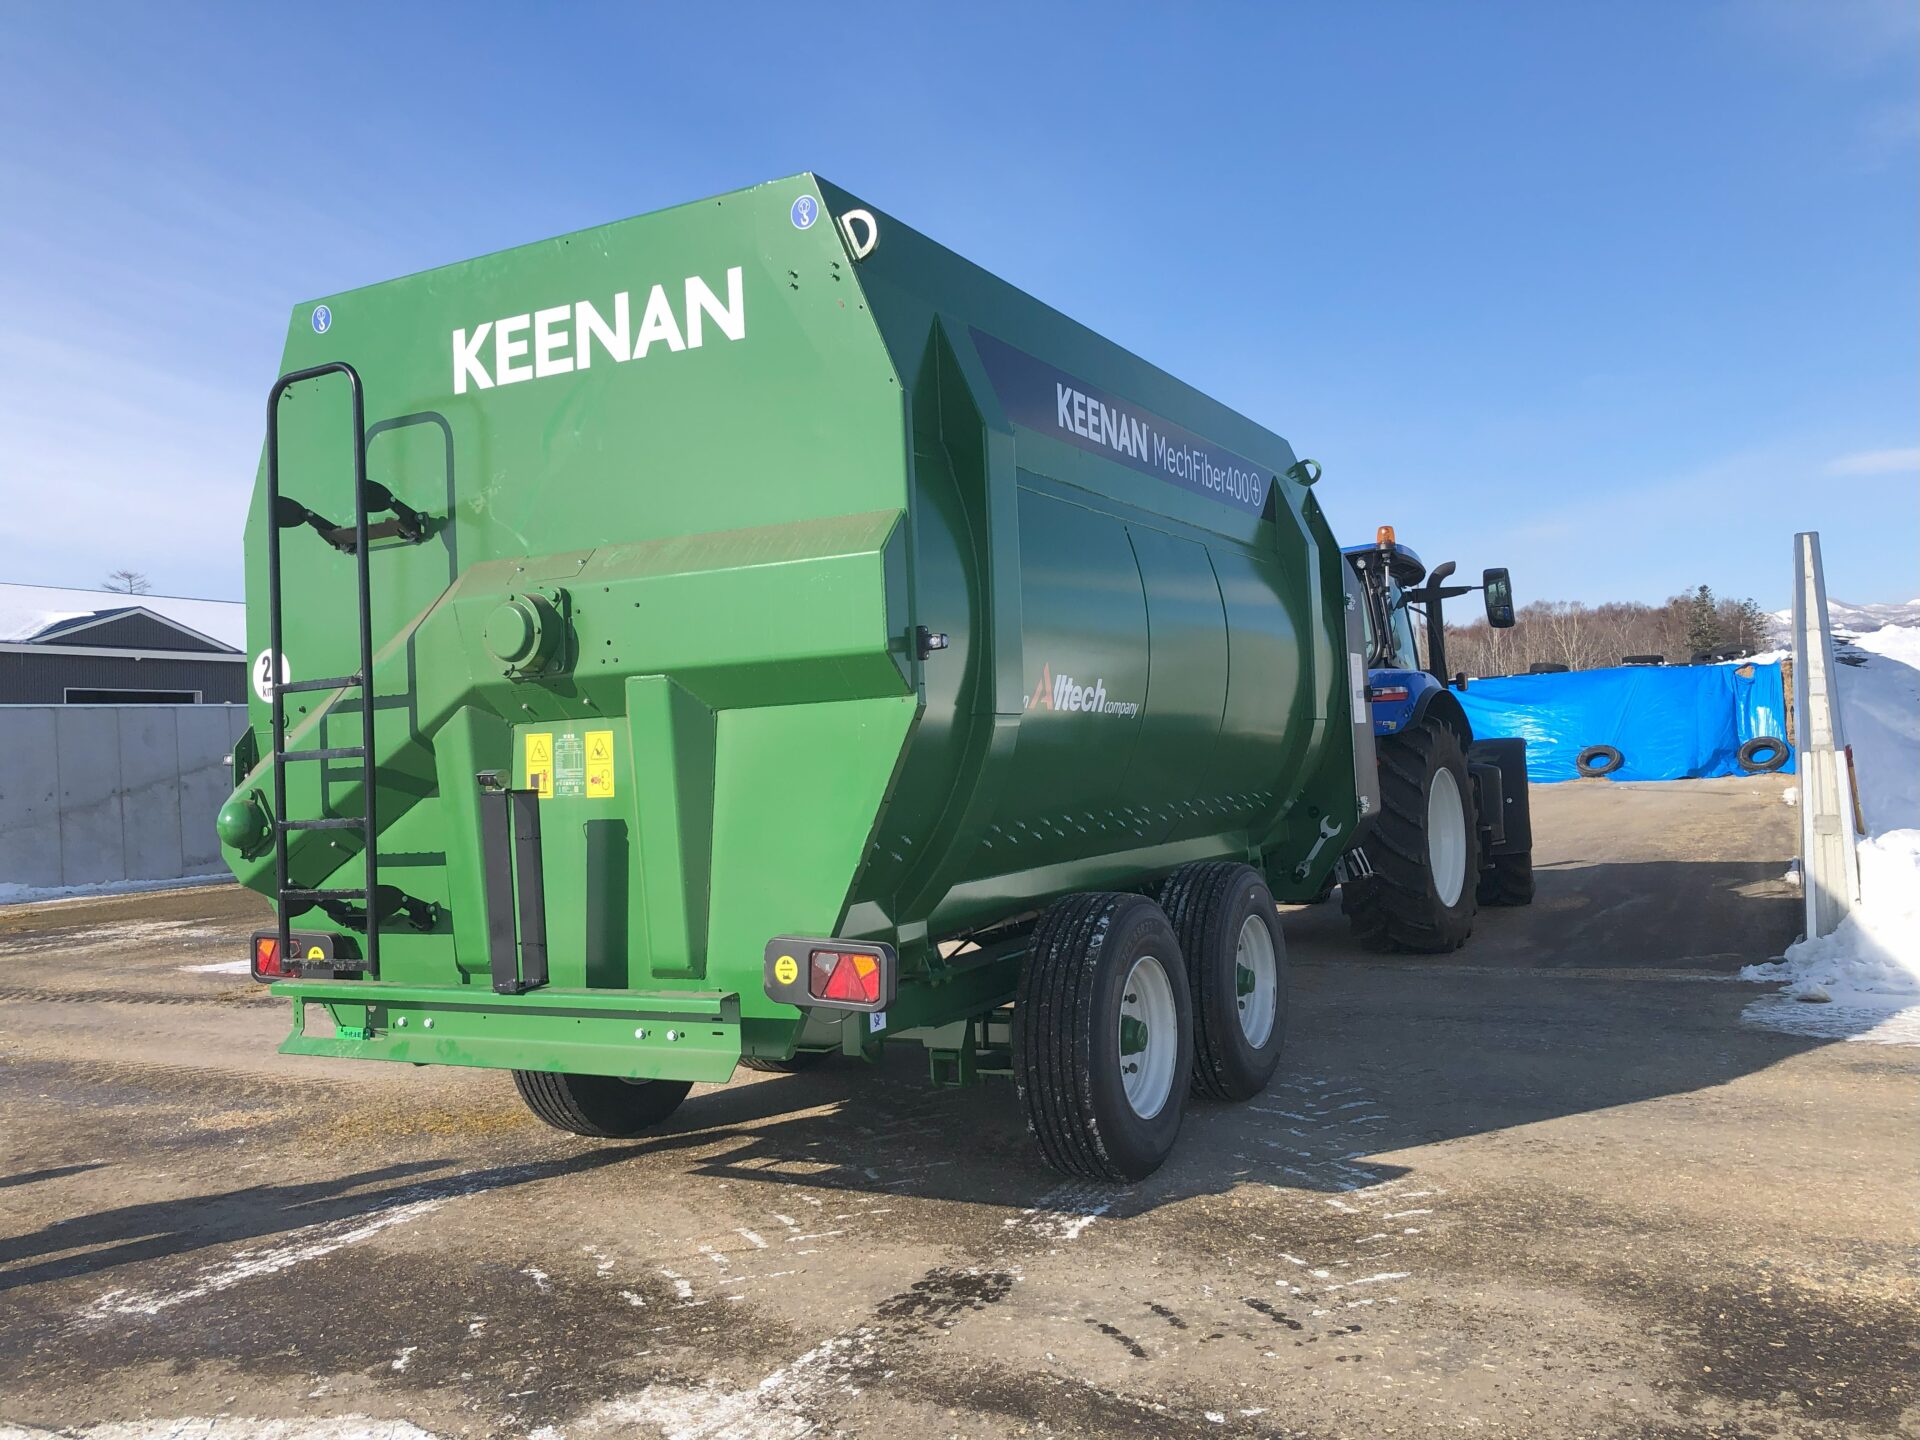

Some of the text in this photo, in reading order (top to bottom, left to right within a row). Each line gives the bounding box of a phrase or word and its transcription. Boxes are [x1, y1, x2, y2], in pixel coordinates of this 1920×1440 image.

[452, 266, 746, 395] KEENAN
[1056, 382, 1148, 463] KEENAN
[1028, 662, 1106, 712] Alltech
[1104, 701, 1140, 719] company
